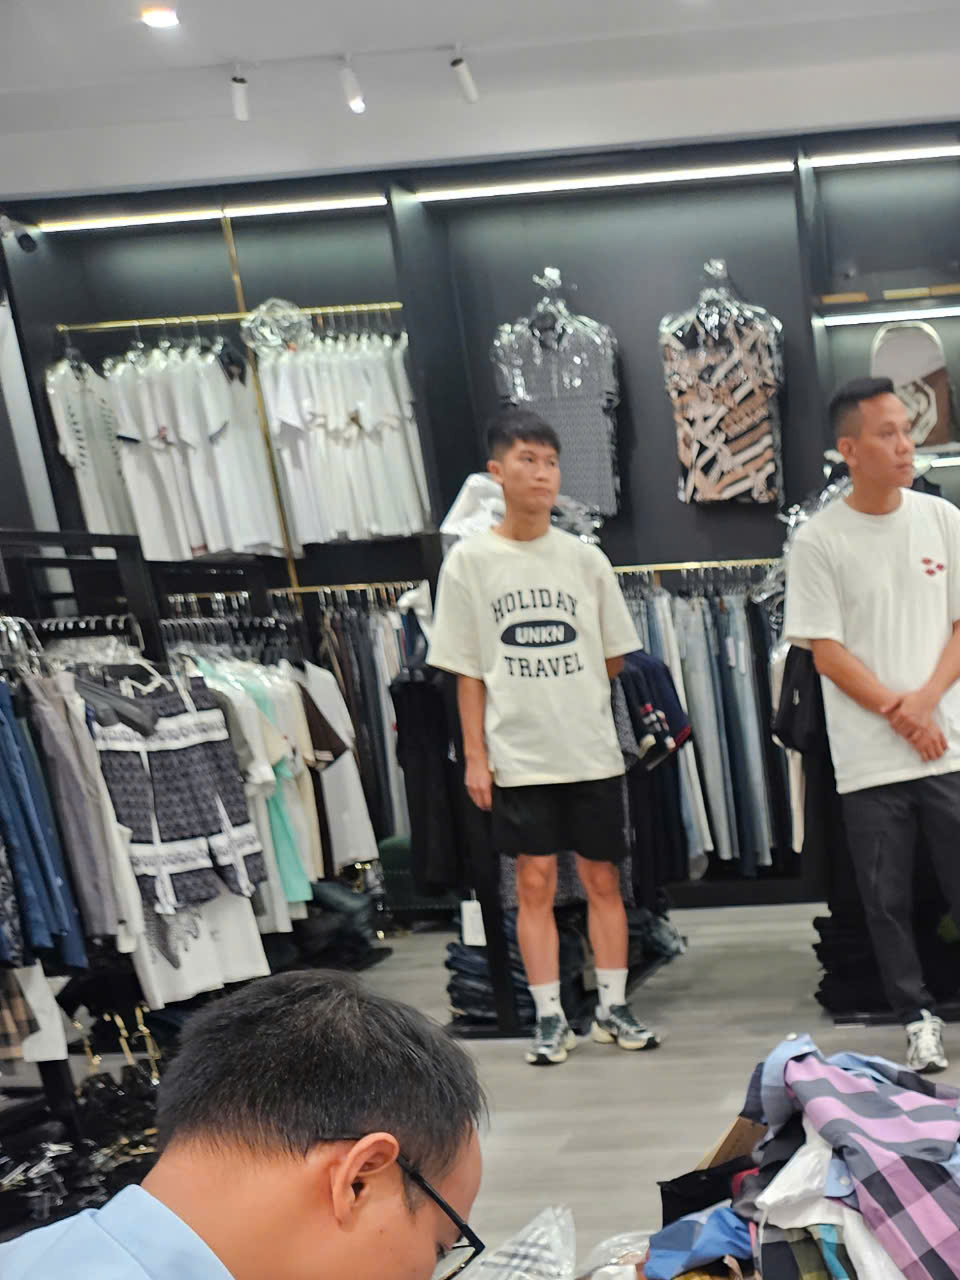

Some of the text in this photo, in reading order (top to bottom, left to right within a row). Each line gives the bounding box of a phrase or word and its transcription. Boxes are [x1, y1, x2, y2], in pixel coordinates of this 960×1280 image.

[490, 588, 578, 623] HOLIDAY
[514, 624, 565, 644] UNKN
[503, 652, 585, 678] TRAVEL
